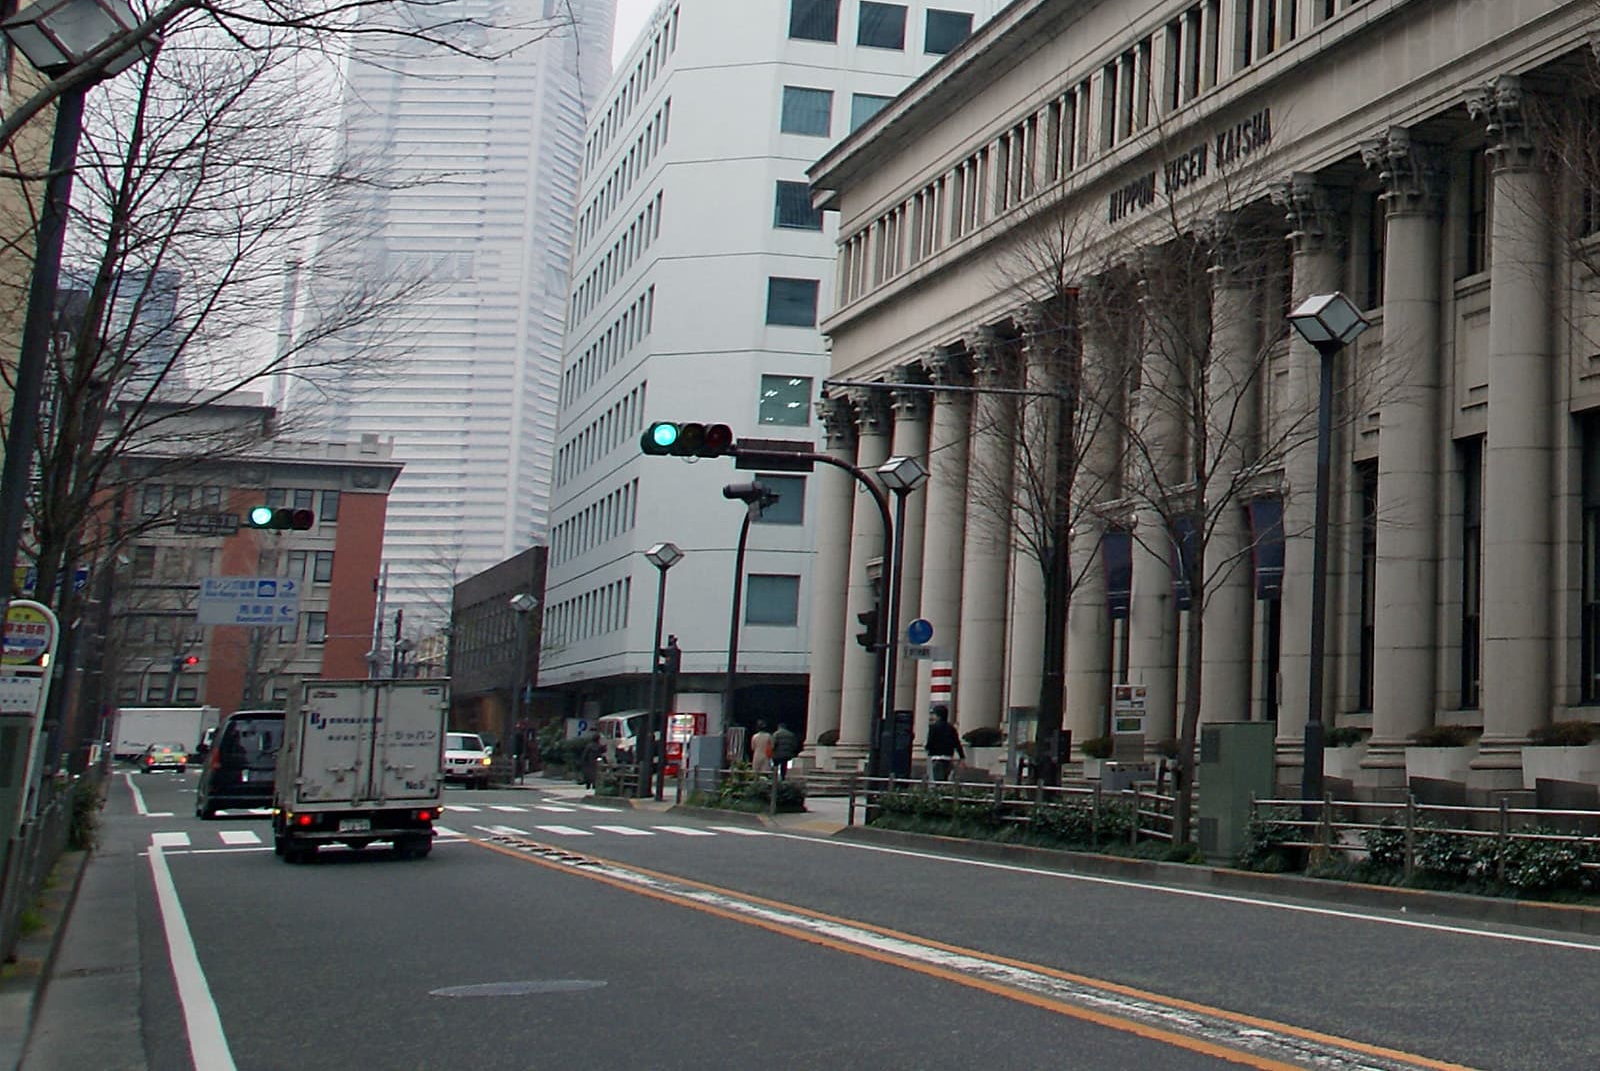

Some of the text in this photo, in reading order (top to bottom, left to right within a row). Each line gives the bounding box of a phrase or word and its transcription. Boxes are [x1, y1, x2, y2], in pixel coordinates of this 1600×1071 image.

[1109, 108, 1272, 224] NIPPON YUSEN KAISHA
